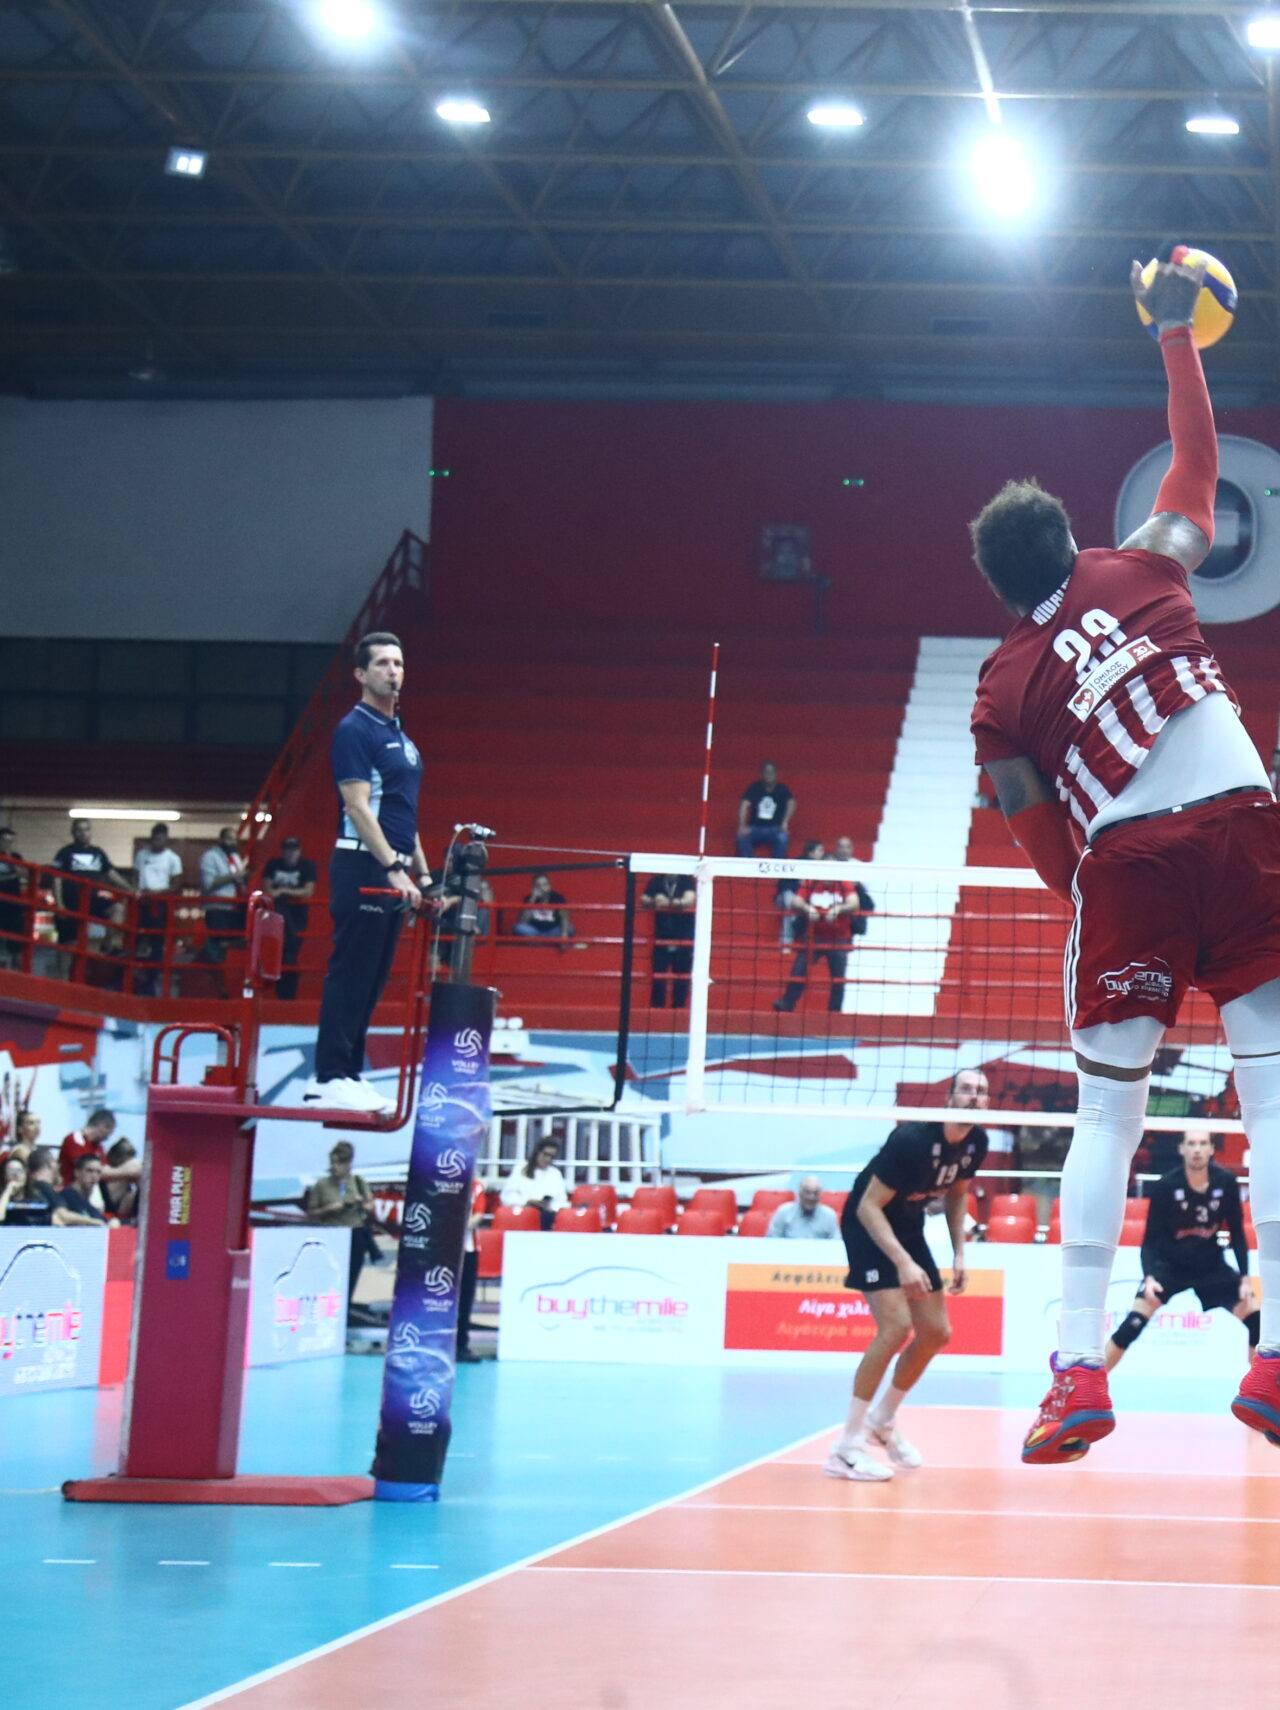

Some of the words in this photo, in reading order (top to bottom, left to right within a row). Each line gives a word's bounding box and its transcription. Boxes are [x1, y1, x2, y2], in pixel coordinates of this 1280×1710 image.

[1093, 661, 1122, 685] ΟΜΙΛΟΣ
[1098, 664, 1130, 691] ΙΑΤΡΙΚΟΥ
[935, 1164, 959, 1186] 19
[1195, 1206, 1208, 1222] 3
[537, 1294, 689, 1320] buythemile
